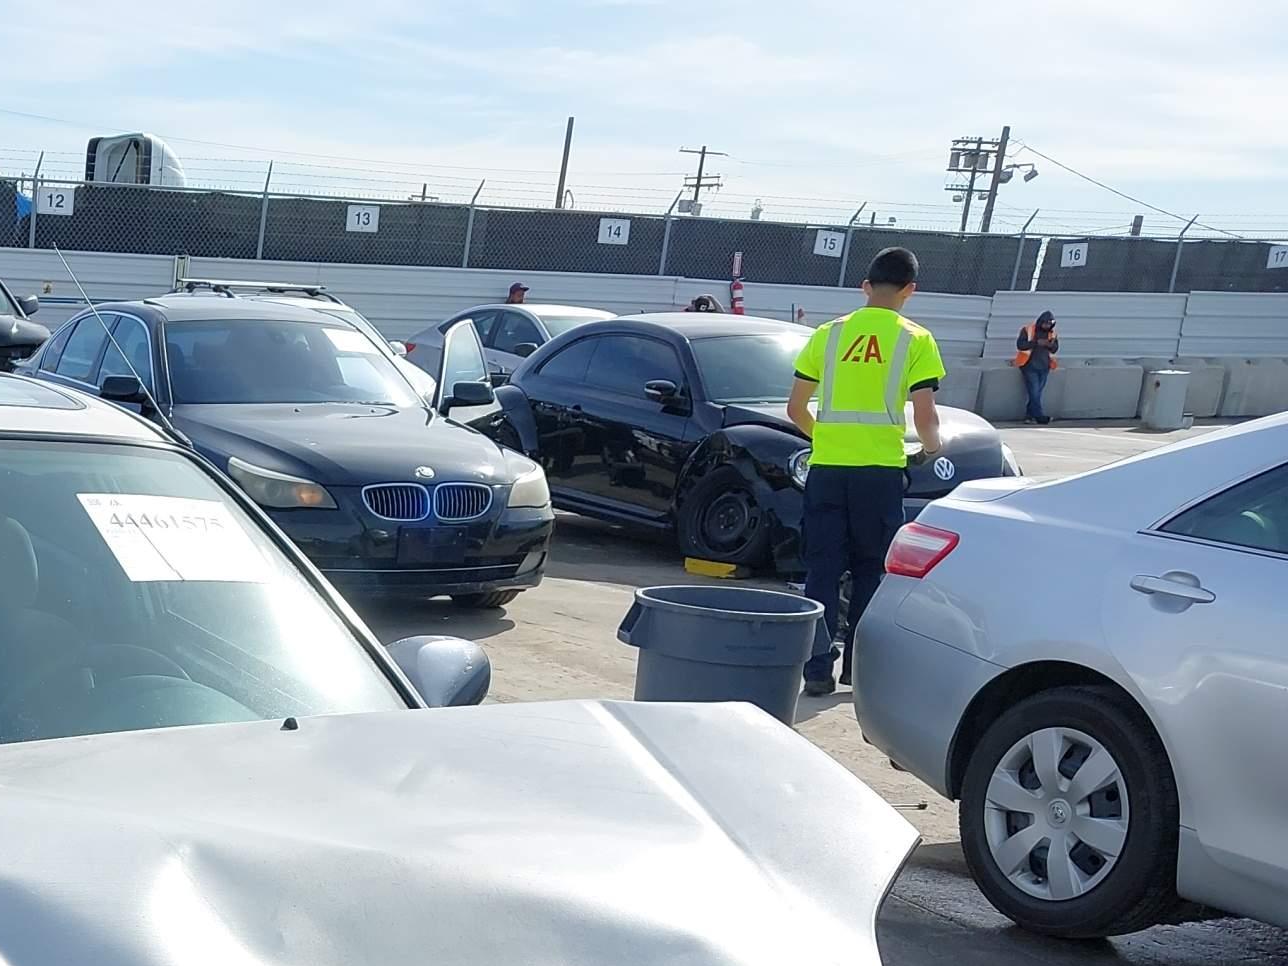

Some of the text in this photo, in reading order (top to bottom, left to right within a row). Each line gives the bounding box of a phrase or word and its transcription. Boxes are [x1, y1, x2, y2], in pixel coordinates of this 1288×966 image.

[47, 193, 65, 208] 12
[355, 211, 371, 226] 13
[607, 224, 622, 239] 14
[822, 237, 837, 251] 15
[1068, 248, 1081, 261] 16
[1274, 250, 1287, 262] 17
